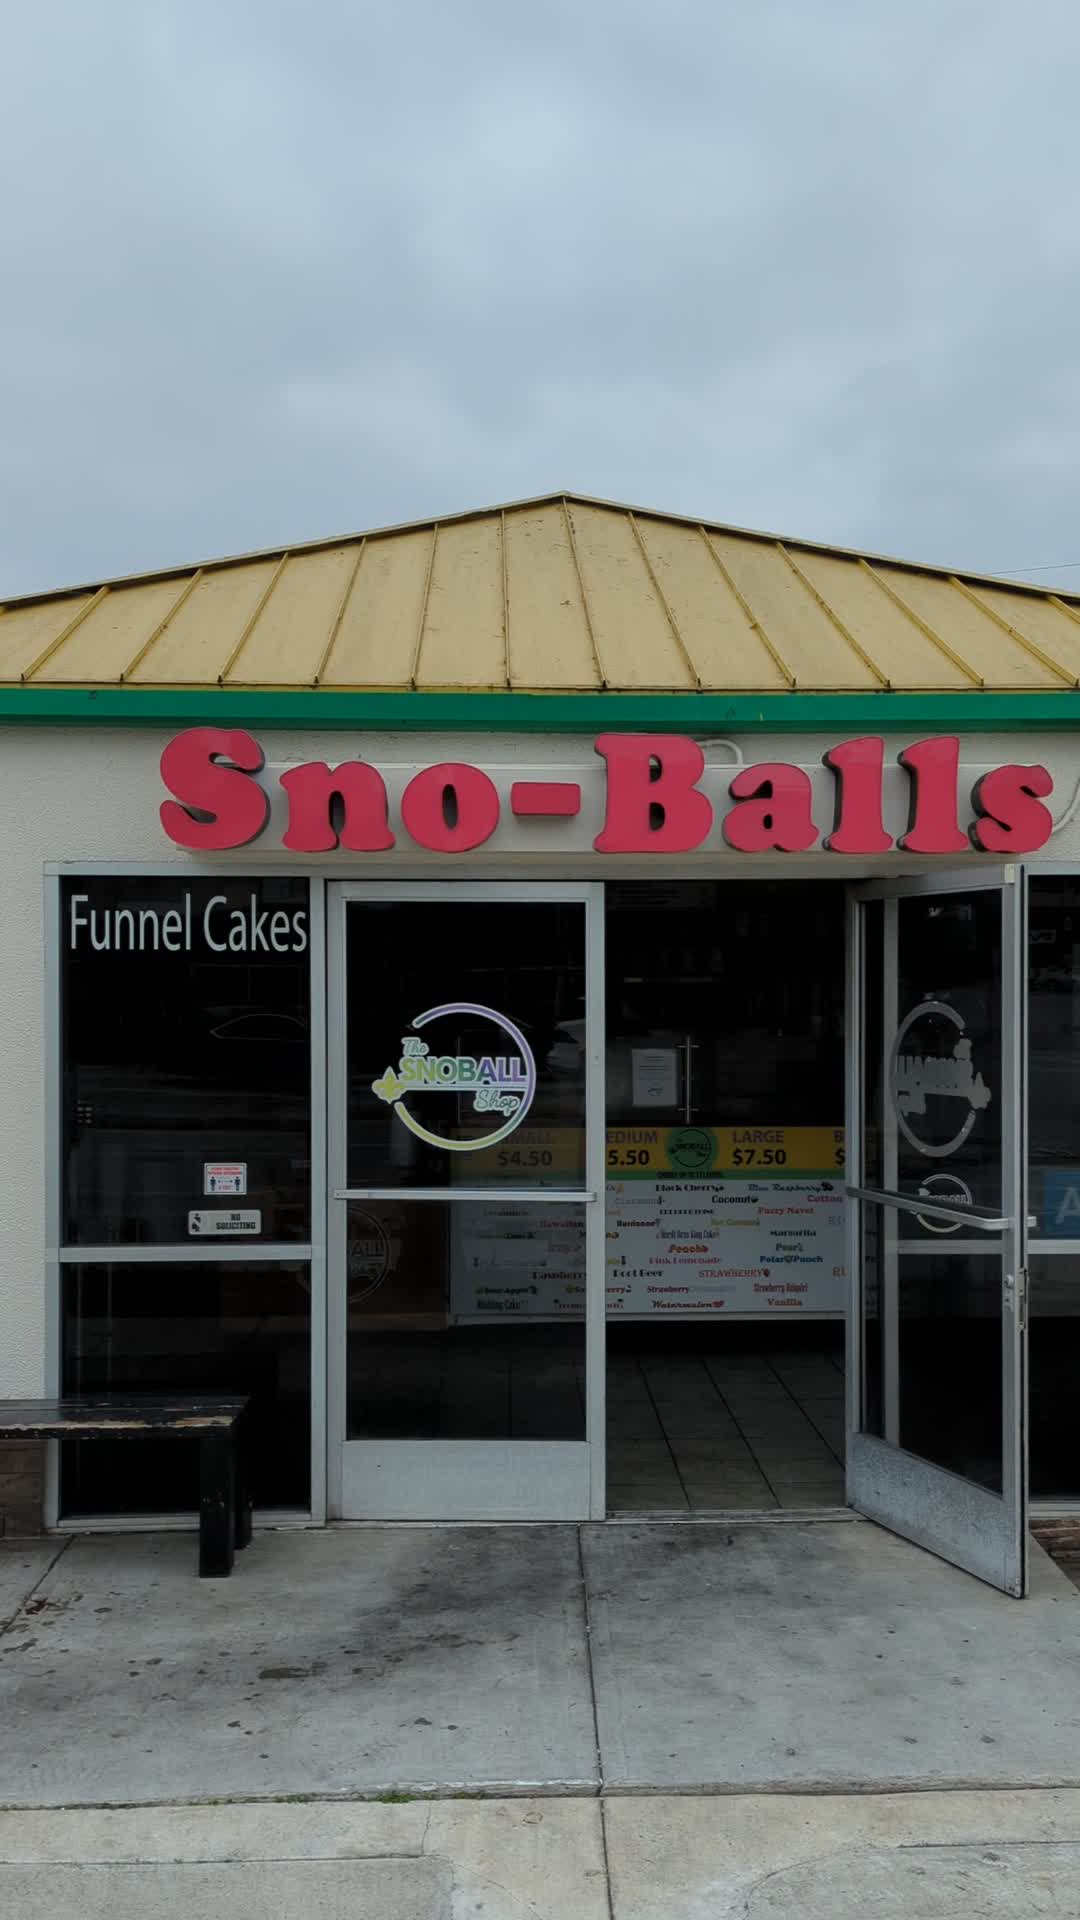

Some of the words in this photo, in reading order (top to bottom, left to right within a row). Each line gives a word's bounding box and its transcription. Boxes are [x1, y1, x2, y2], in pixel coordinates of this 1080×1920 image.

[160, 727, 1054, 853] Sno-Balls
[71, 893, 191, 952] Funnel
[203, 894, 307, 952] Cakes
[402, 1039, 428, 1055] The
[401, 1058, 526, 1083] SNOBALL
[475, 1089, 520, 1116] Shop
[607, 1131, 658, 1144] EDIUM
[733, 1130, 785, 1144] LARGE
[497, 1148, 553, 1168] $4.50
[607, 1149, 650, 1166] 5.50
[732, 1148, 787, 1167] $7.50
